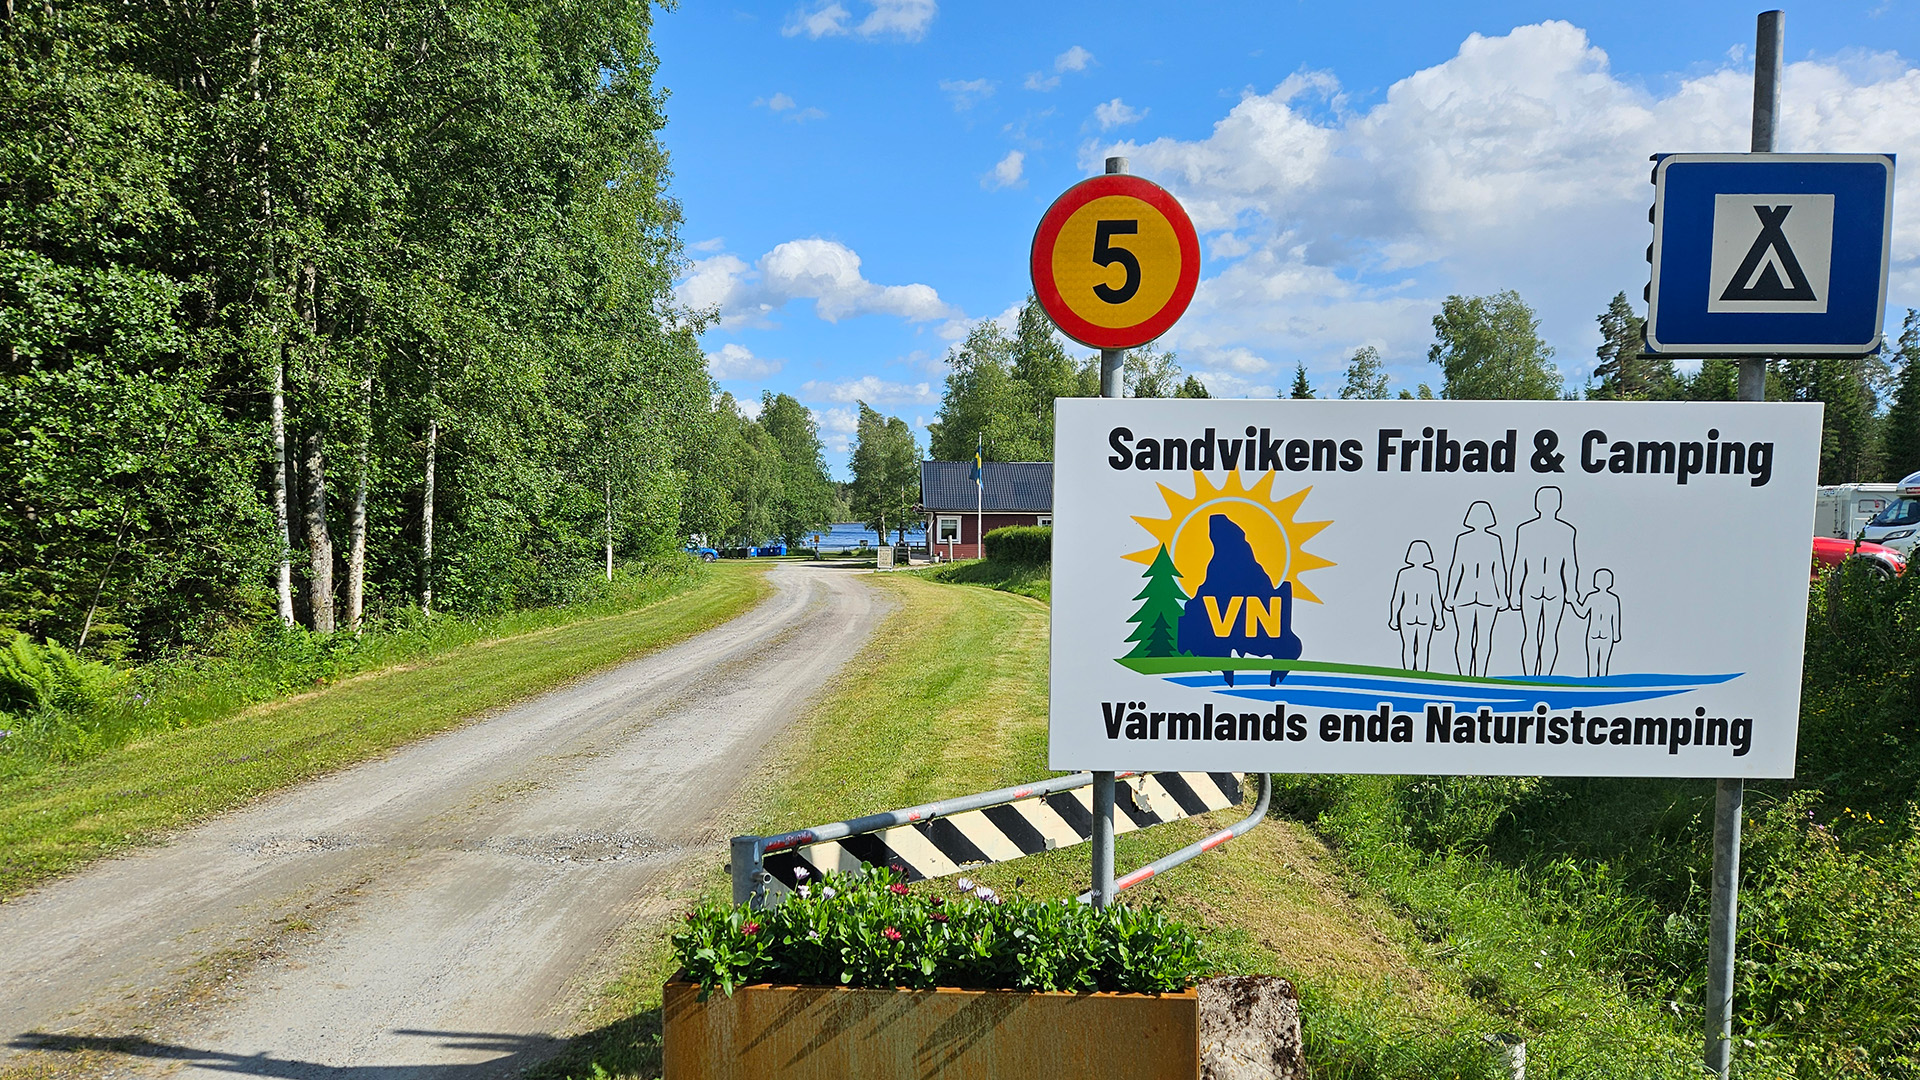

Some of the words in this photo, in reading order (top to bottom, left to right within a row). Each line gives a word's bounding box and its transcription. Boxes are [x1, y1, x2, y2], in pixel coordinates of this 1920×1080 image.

[1093, 219, 1141, 304] 5
[1108, 426, 1363, 472] Sandvikens
[1377, 427, 1516, 473] Fribad
[1531, 429, 1565, 473] &
[1580, 428, 1774, 487] Camping
[1203, 595, 1282, 638] VN
[1101, 701, 1308, 742] Värmlands
[1319, 705, 1414, 743] enda
[1425, 705, 1753, 757] Naturistcamping
